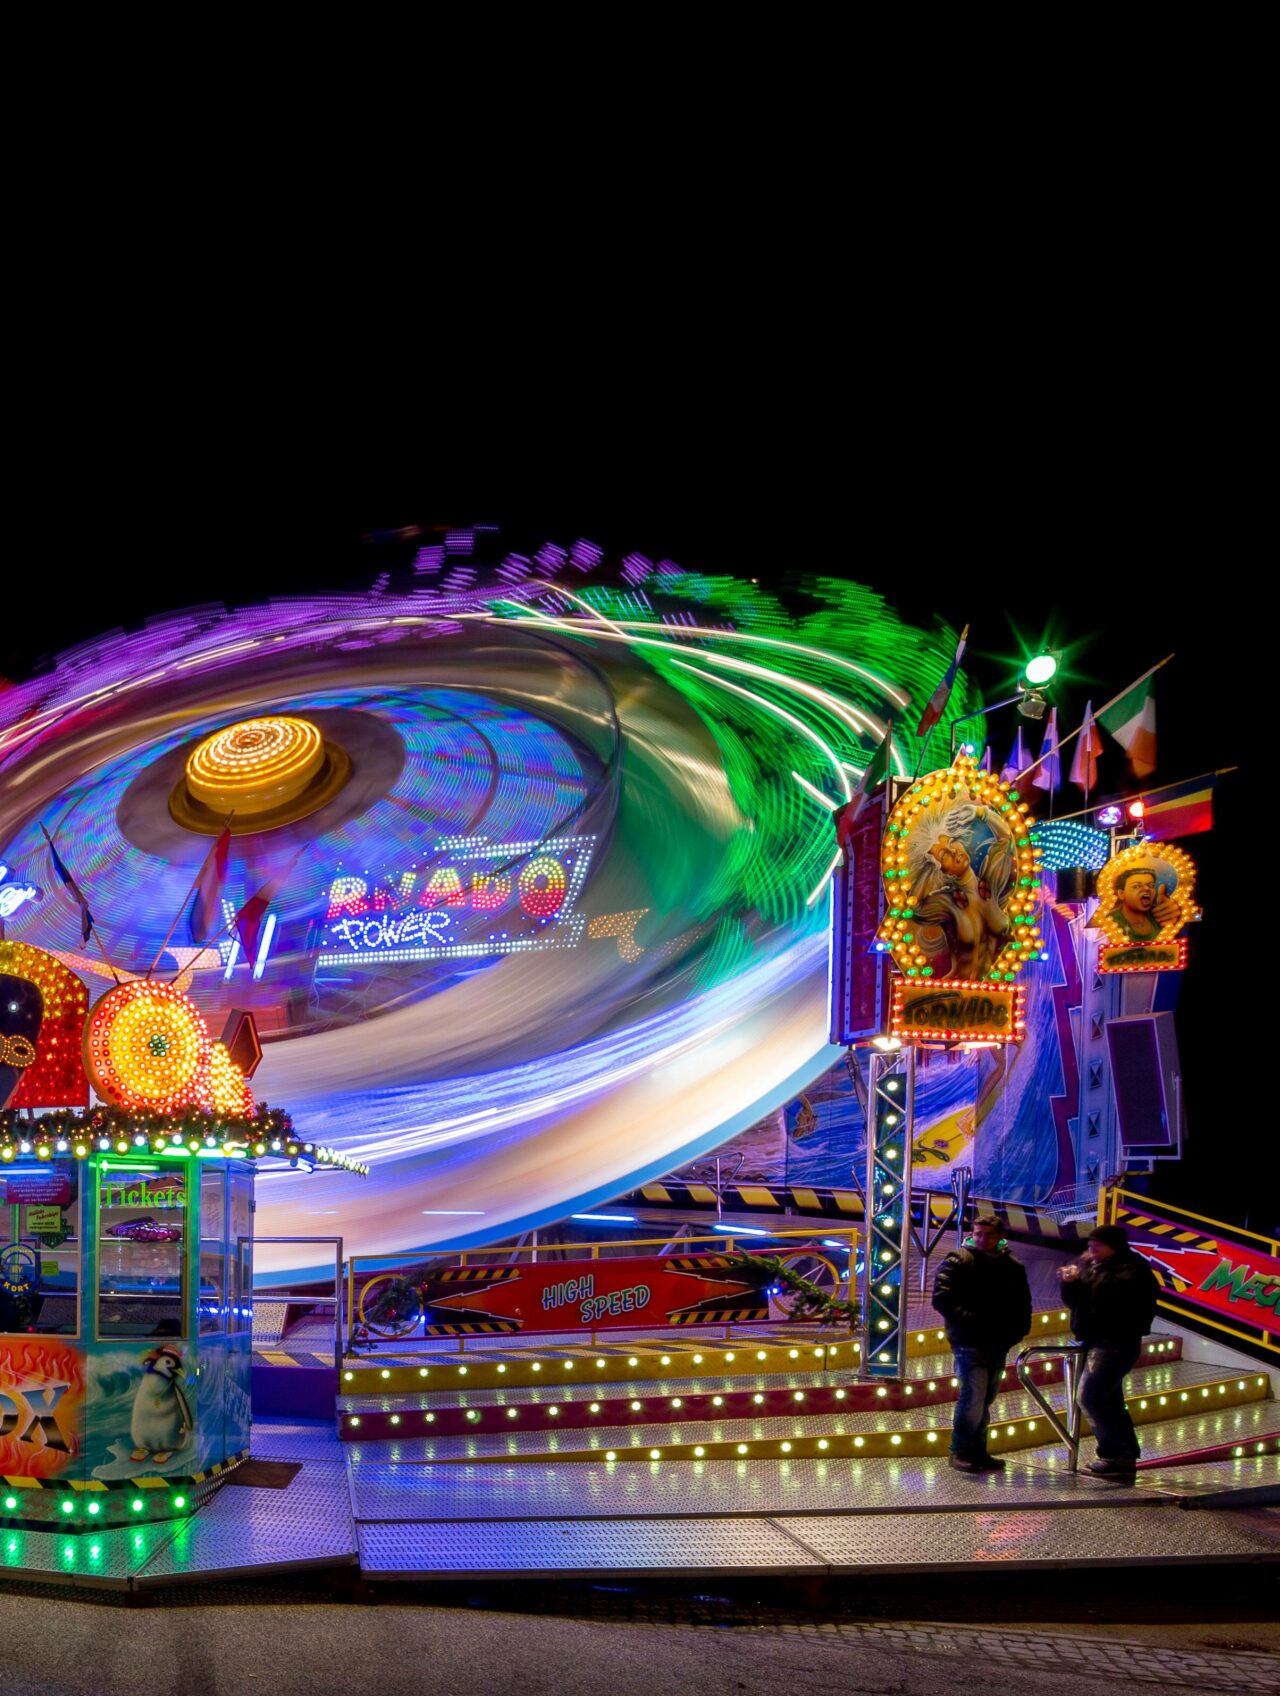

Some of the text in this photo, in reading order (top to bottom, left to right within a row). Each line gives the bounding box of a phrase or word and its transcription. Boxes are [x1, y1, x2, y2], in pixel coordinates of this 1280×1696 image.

[331, 910, 451, 950] POWER
[900, 991, 1008, 1029] TORNADO
[103, 1182, 187, 1208] Tickets
[542, 1274, 594, 1310] HIGH
[580, 1284, 651, 1323] SPEED
